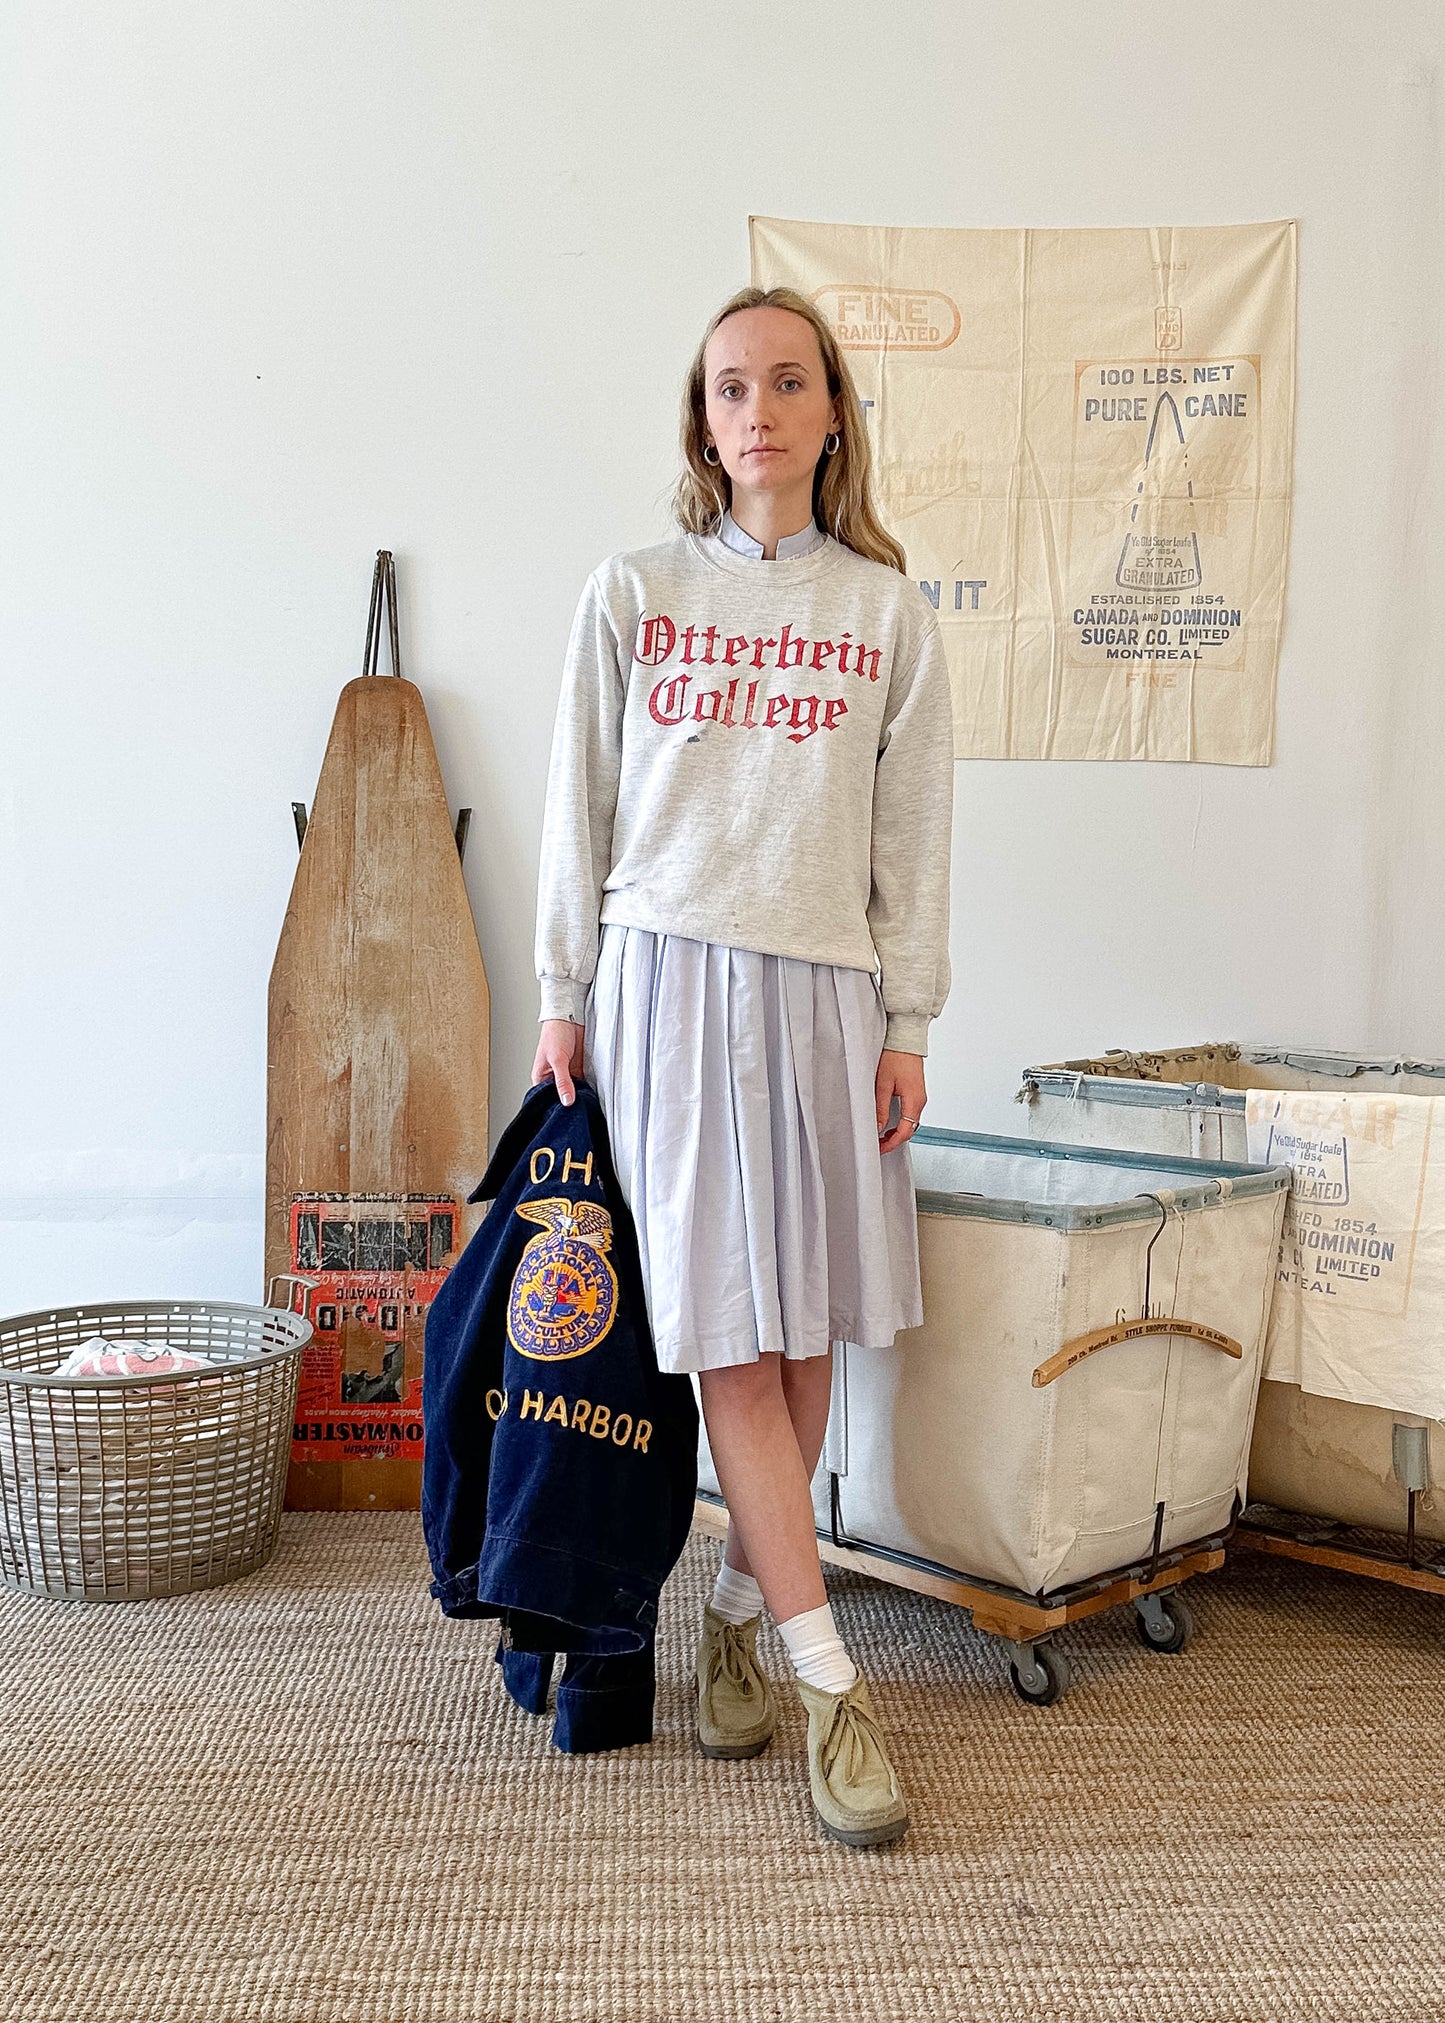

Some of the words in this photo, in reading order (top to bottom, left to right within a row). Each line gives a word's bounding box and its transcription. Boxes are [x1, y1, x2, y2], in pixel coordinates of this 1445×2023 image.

[837, 295, 928, 324] FINE
[828, 324, 940, 342] GRANULATED
[1100, 368, 1135, 385] 100
[1143, 368, 1187, 384] LBS.
[1193, 365, 1234, 384] NET
[1085, 397, 1148, 422] PURE
[1185, 393, 1247, 418] CANE
[1135, 557, 1184, 568] EXTRA
[1123, 568, 1195, 586] GRANULATED
[955, 581, 987, 609] IT
[1091, 595, 1180, 605] ESTABLISHED
[1190, 595, 1225, 605] 1854
[1073, 609, 1139, 625] CANADA
[1142, 613, 1158, 622] AND
[1160, 609, 1241, 626] DOMINION
[1081, 628, 1139, 645] SUGAR
[1146, 629, 1171, 645] CO.
[632, 613, 883, 683] Otterbein
[1106, 649, 1203, 660] MONTREAL
[1125, 672, 1177, 688] FINE
[648, 673, 849, 744] College
[1248, 1097, 1397, 1149] UGAR
[1296, 1137, 1318, 1152] Sugar
[1300, 1151, 1323, 1162] 1854
[1294, 1178, 1343, 1199] ULATED
[1333, 1217, 1378, 1235] 1854
[1298, 1228, 1395, 1262] DOMINION
[525, 1254, 595, 1291] VOCATIONAL
[1274, 1270, 1337, 1295] NTEAL
[1125, 1326, 1143, 1338] STYLE
[520, 1388, 653, 1454] HARBOR
[292, 1423, 424, 1441] ONMASTER
